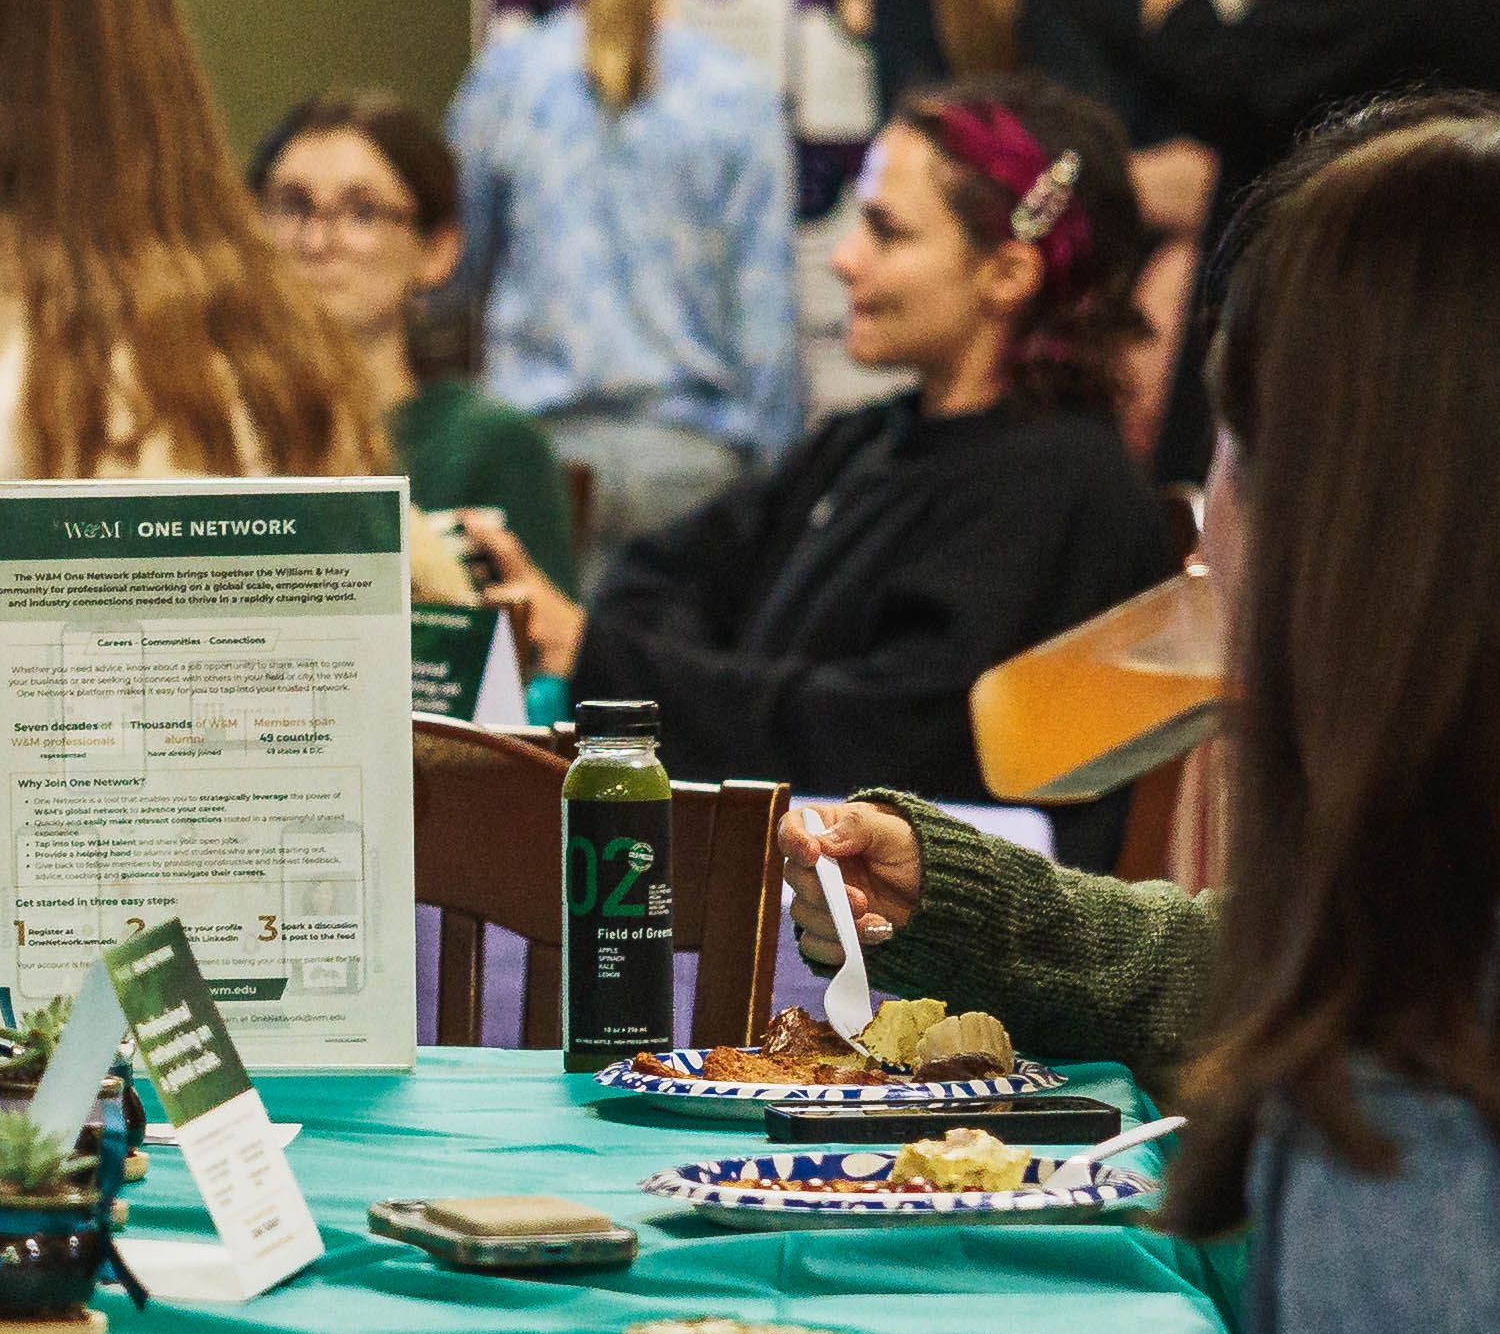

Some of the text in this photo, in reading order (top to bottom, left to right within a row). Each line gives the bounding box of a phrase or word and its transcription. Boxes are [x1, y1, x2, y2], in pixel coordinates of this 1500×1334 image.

[63, 518, 297, 540] W&M ONE NETWORK
[14, 573, 32, 581] The
[34, 572, 62, 581] W&M
[63, 572, 85, 580] One
[86, 571, 129, 580] Network
[131, 570, 175, 581] platform
[176, 569, 209, 580] brings
[210, 568, 254, 580] together
[256, 568, 273, 577] the
[274, 567, 313, 576] William
[324, 567, 350, 577] Mary
[50, 585, 65, 593] for
[66, 584, 128, 595] professional
[129, 583, 187, 594] networking
[212, 582, 244, 592] global
[245, 581, 274, 592] scale,
[275, 581, 339, 591] empowering
[8, 599, 27, 607] and
[29, 598, 70, 609] industry
[72, 597, 134, 606] connections
[135, 596, 173, 605] needed
[174, 596, 186, 604] to
[188, 595, 217, 604] thrive
[219, 595, 230, 603] in
[239, 594, 274, 605] rapidly
[275, 593, 323, 604] changing
[325, 592, 357, 601] world.
[97, 636, 266, 647] Careers Communities Connections
[14, 721, 113, 732] Seven decades of
[130, 719, 193, 729] Thousands
[195, 719, 207, 729] of
[254, 718, 336, 729] Members span
[11, 736, 116, 749] W&M professionals
[164, 734, 205, 745] alumni
[259, 732, 333, 743] 49 countries.
[17, 777, 146, 790] Why Join One Network?
[199, 793, 251, 803] strategically
[252, 792, 289, 802] leverage
[64, 807, 92, 817] global
[93, 806, 127, 815] network
[140, 805, 176, 814] advance
[177, 807, 197, 815] your
[83, 816, 222, 827] easily make relevant connections
[34, 840, 50, 850] Tap
[70, 840, 86, 849] top
[111, 838, 136, 846] talent
[34, 849, 132, 859] Provide helping hand
[121, 870, 160, 880] guidance
[172, 870, 209, 879] navigate
[210, 869, 231, 877] their
[566, 834, 646, 916] 02
[15, 897, 179, 908] Get started in three easy steps:
[193, 925, 213, 933] your
[215, 923, 243, 933] profile
[257, 915, 278, 942] 3
[281, 922, 305, 931] Spark
[314, 921, 358, 930] discussion
[13, 919, 26, 947] 1
[28, 928, 64, 937] Register
[289, 933, 308, 942] post
[320, 932, 335, 940] the
[336, 932, 356, 940] feed
[597, 928, 629, 940] Field
[631, 927, 644, 939] of
[188, 934, 239, 943] ith LinkedIn
